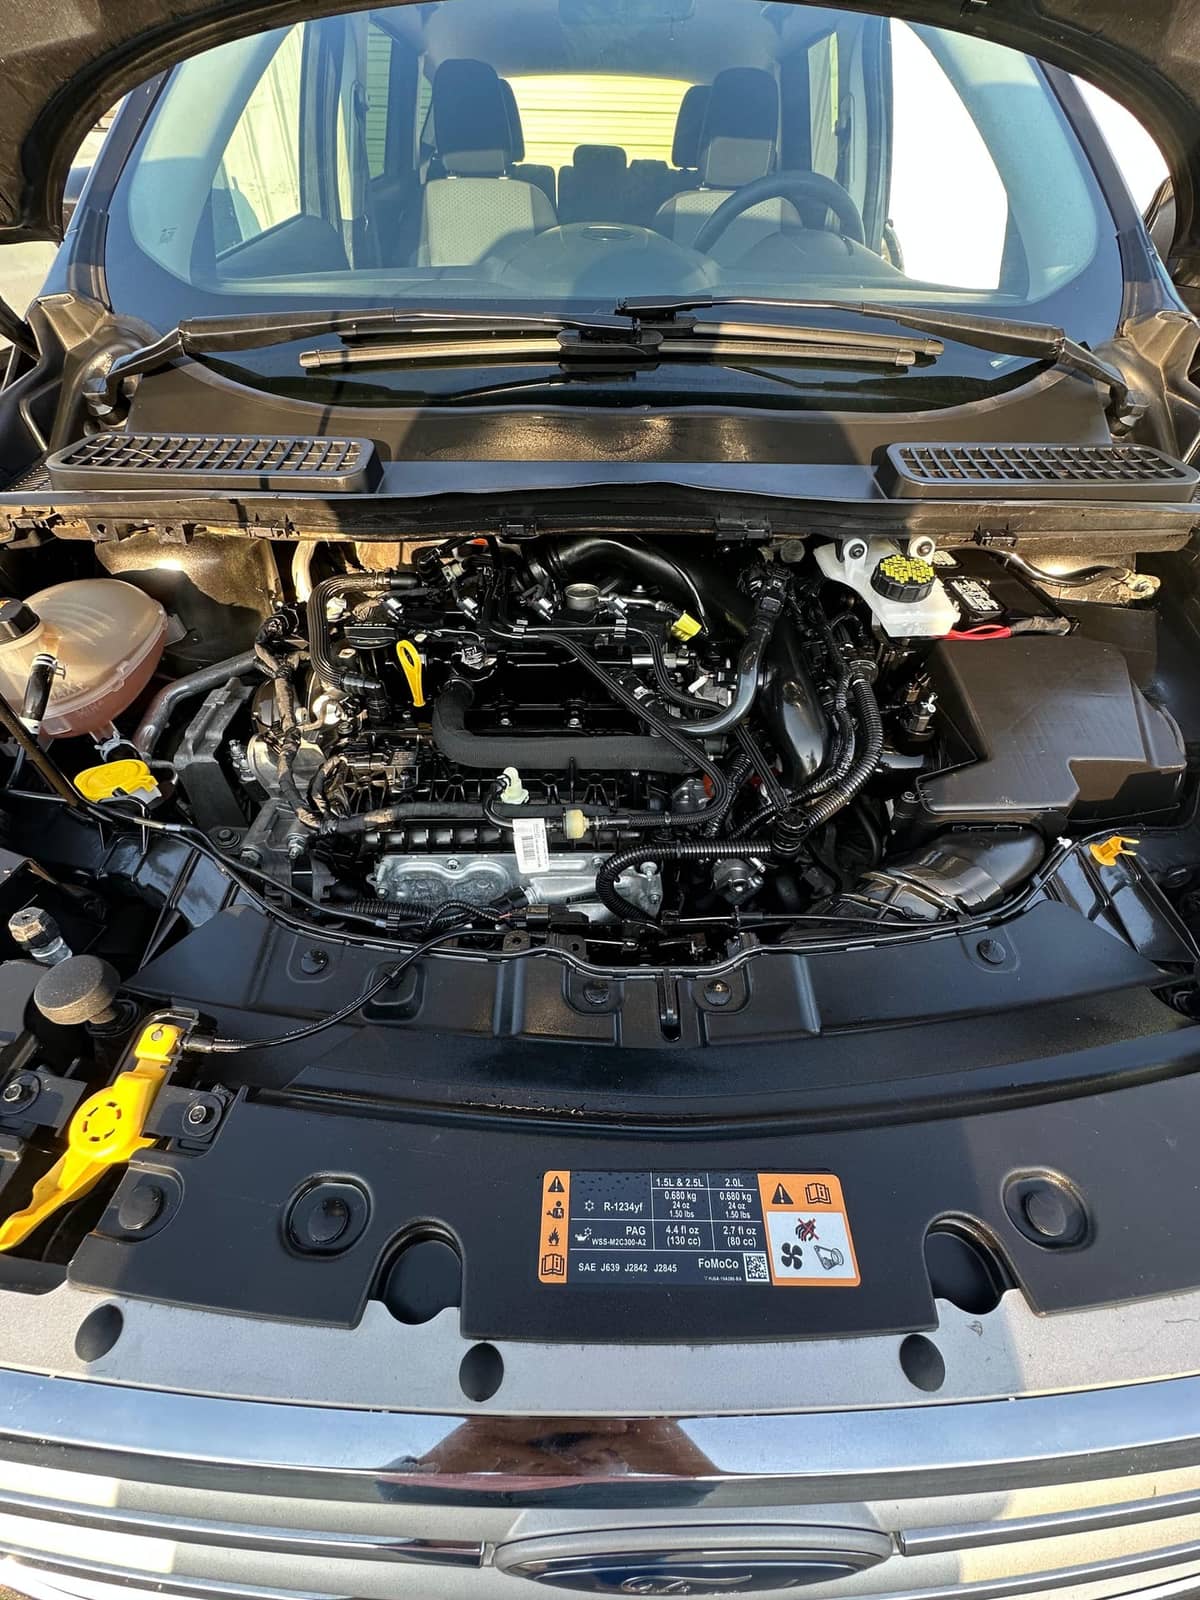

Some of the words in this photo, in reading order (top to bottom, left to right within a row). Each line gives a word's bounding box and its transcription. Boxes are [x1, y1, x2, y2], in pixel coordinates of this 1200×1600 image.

[656, 1178, 674, 1187] 1.5L
[676, 1178, 683, 1187] &
[685, 1178, 704, 1187] 2.5L
[725, 1178, 744, 1187] 2.0L
[664, 1191, 685, 1200] 0.680
[686, 1191, 697, 1202] kg
[719, 1192, 740, 1201] 0.680
[741, 1192, 752, 1203] kg
[603, 1202, 643, 1214] R-1234yf
[672, 1201, 680, 1209] 24
[728, 1202, 736, 1210] 24
[740, 1211, 751, 1219] lbs
[625, 1225, 646, 1235] PAG
[665, 1225, 679, 1234] 4.4
[680, 1225, 687, 1234] fl
[722, 1226, 735, 1235] 2.7
[737, 1226, 744, 1235] fl
[745, 1227, 757, 1235] oz
[591, 1238, 647, 1246] WSS-M2C300-A2
[666, 1236, 685, 1246] (130
[687, 1236, 701, 1247] cc)
[727, 1237, 741, 1247] (80
[742, 1237, 757, 1248] cc)
[578, 1262, 597, 1272] SAE
[600, 1263, 620, 1272] J639
[624, 1263, 648, 1272] J2842
[653, 1264, 677, 1273] J2845
[698, 1258, 739, 1269] FoMoCo
